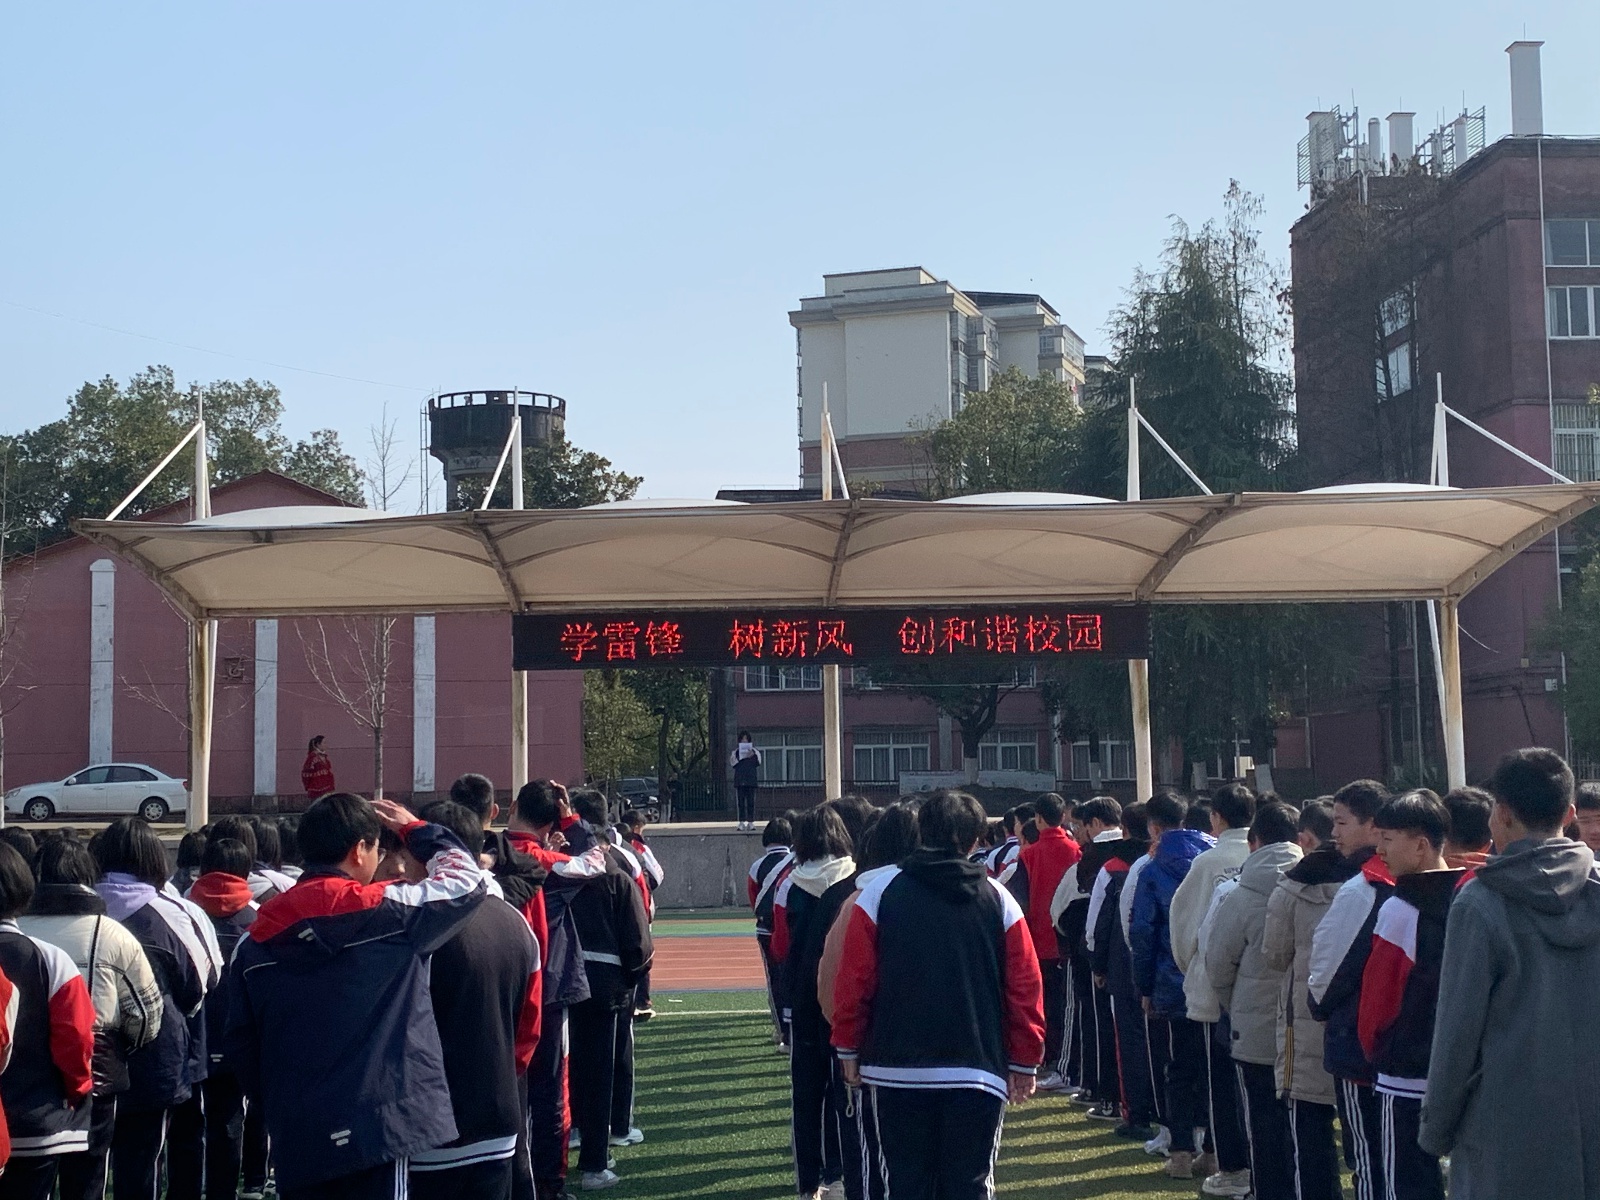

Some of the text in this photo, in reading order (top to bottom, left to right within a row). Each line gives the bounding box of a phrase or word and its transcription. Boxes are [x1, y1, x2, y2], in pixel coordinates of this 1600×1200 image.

[560, 614, 1102, 661] 学雷锋 树新风 创和谐校园
